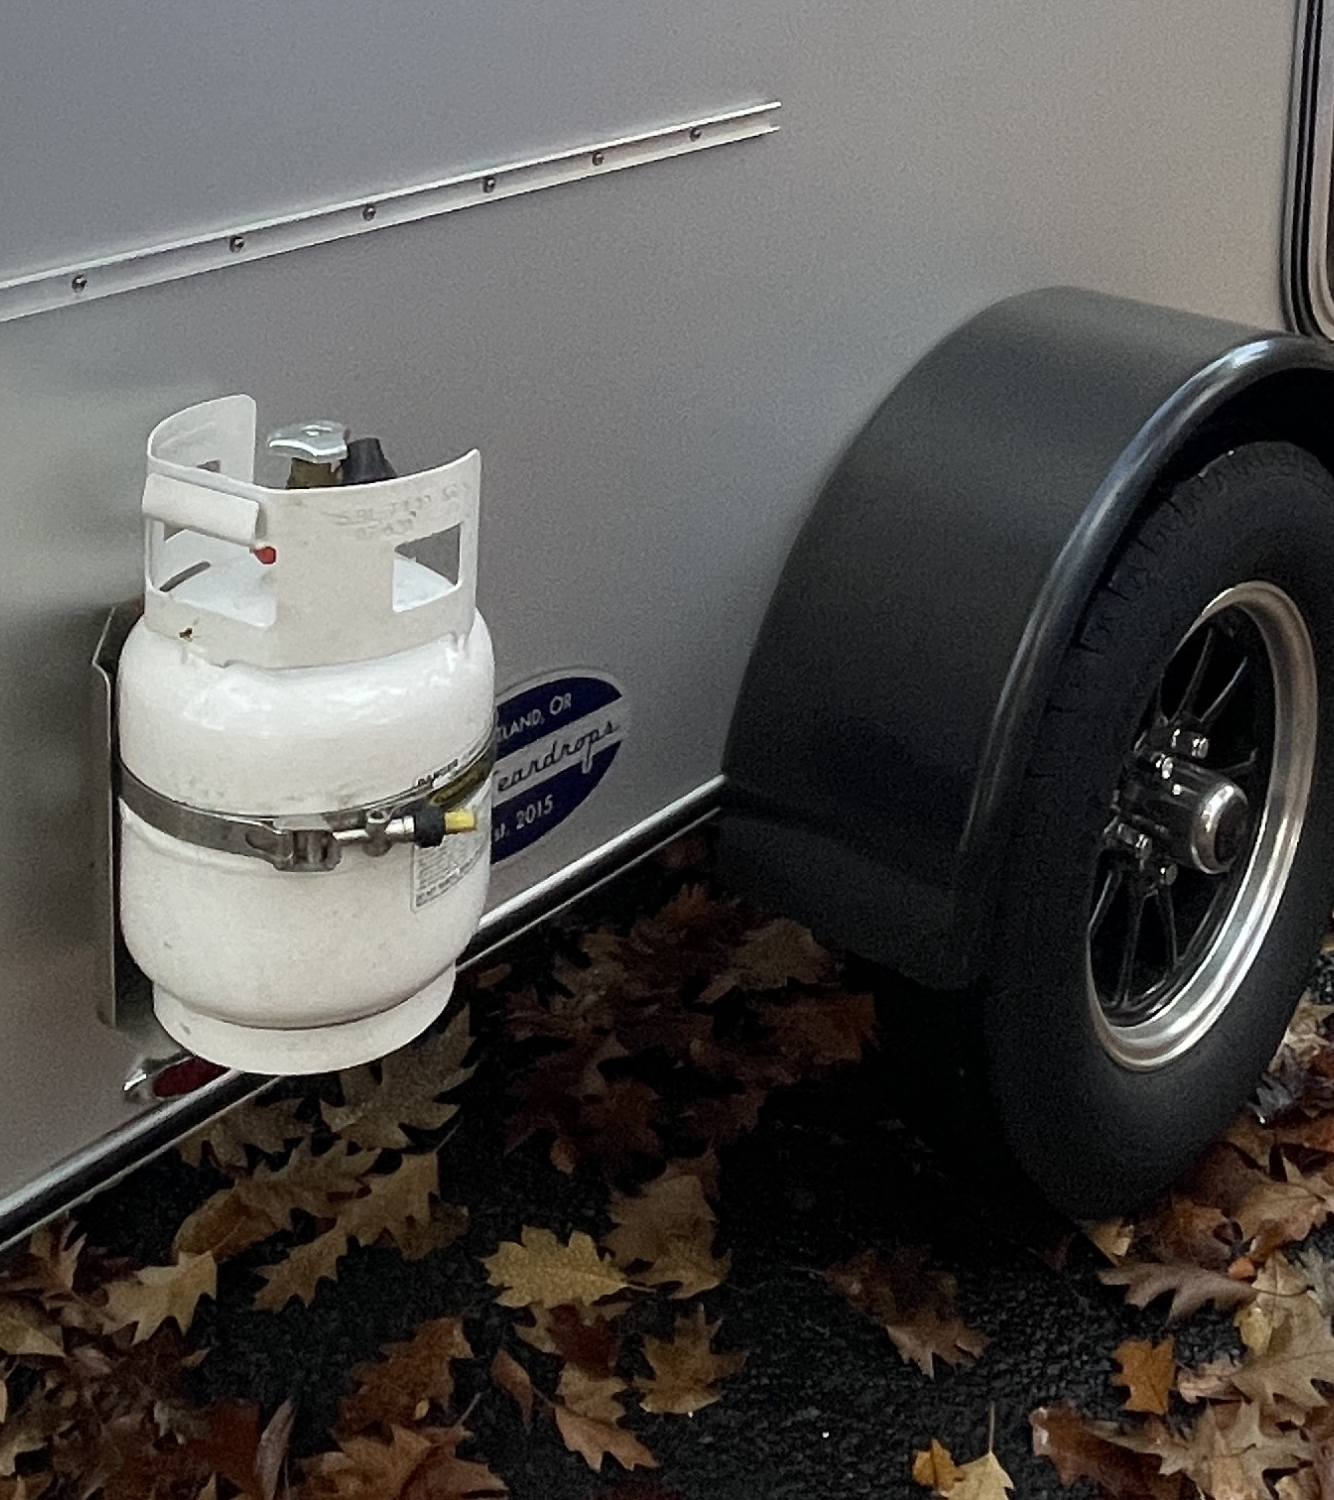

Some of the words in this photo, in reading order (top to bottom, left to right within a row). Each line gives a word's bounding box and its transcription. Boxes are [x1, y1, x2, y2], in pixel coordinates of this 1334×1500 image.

[494, 708, 546, 743] TLAND,
[549, 692, 572, 716] OR
[492, 720, 621, 793] eardrops
[515, 793, 554, 830] 2015
